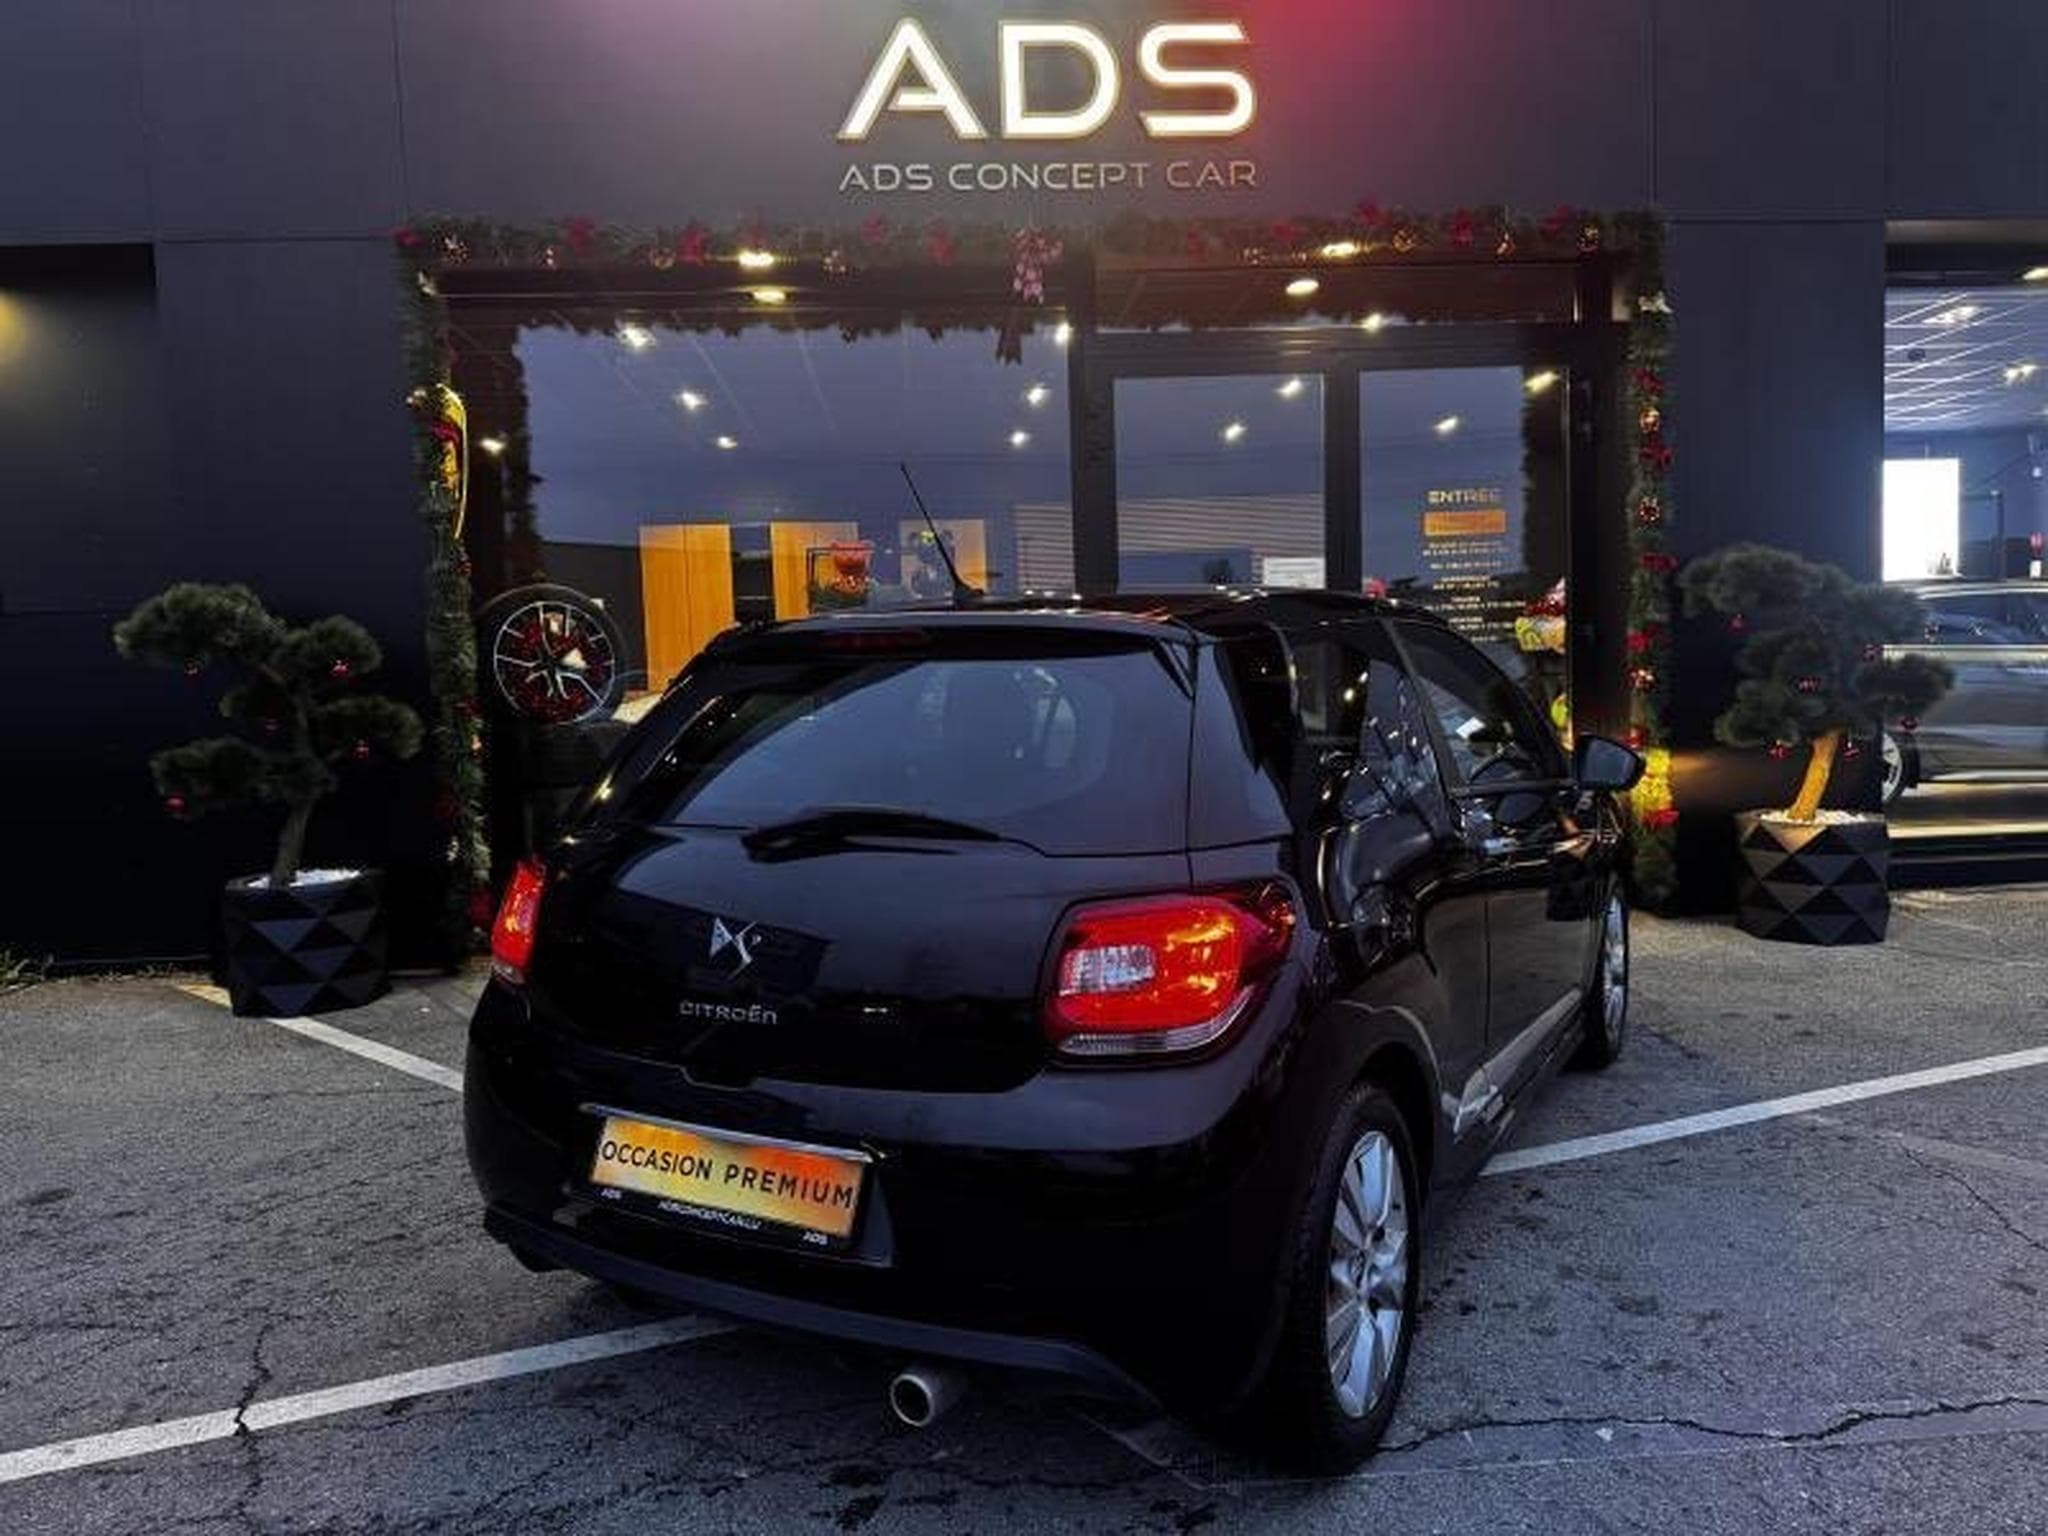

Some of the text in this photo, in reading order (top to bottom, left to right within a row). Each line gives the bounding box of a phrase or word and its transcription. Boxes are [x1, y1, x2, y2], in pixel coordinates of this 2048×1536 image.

[836, 17, 1257, 139] ADS
[839, 159, 1257, 191] ADS CONCEPT CAR
[601, 1139, 854, 1210] OCCASION PREMIUM
